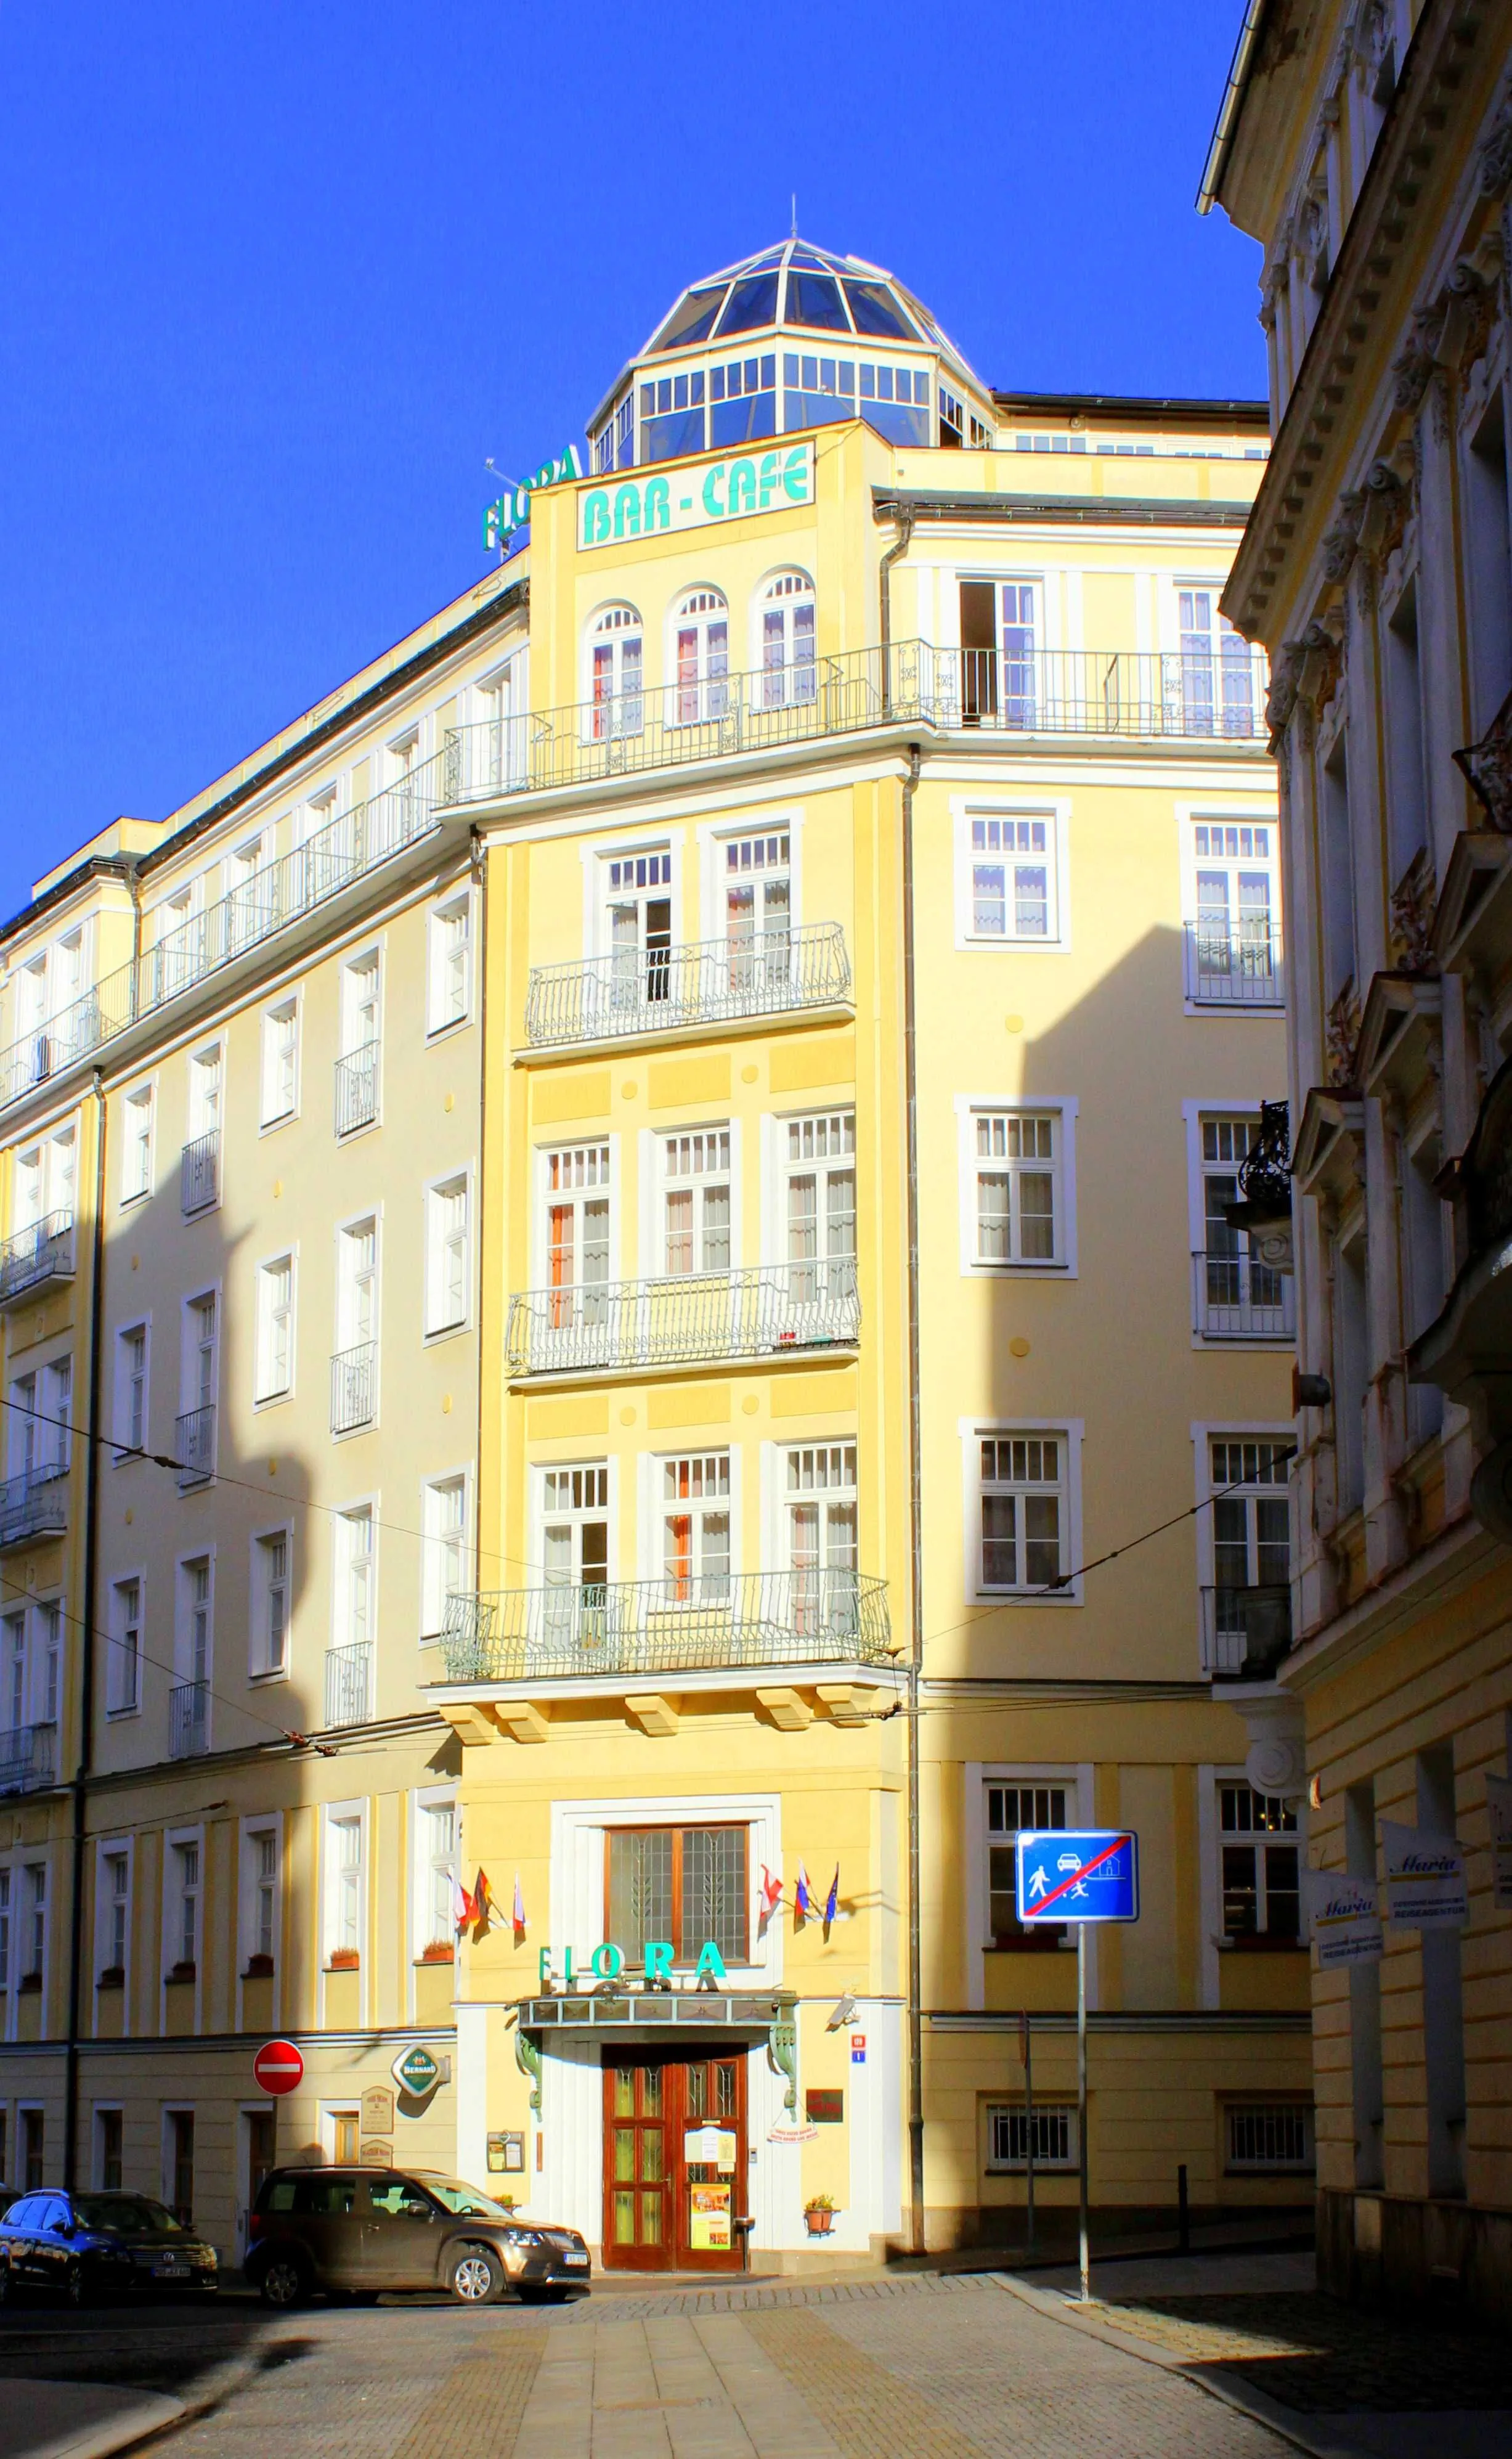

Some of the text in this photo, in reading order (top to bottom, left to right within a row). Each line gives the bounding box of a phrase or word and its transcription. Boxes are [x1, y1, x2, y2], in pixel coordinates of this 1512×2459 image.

[583, 477, 670, 544] BAR
[539, 1942, 728, 1981] FLORA
[404, 2064, 436, 2075] BERNARD
